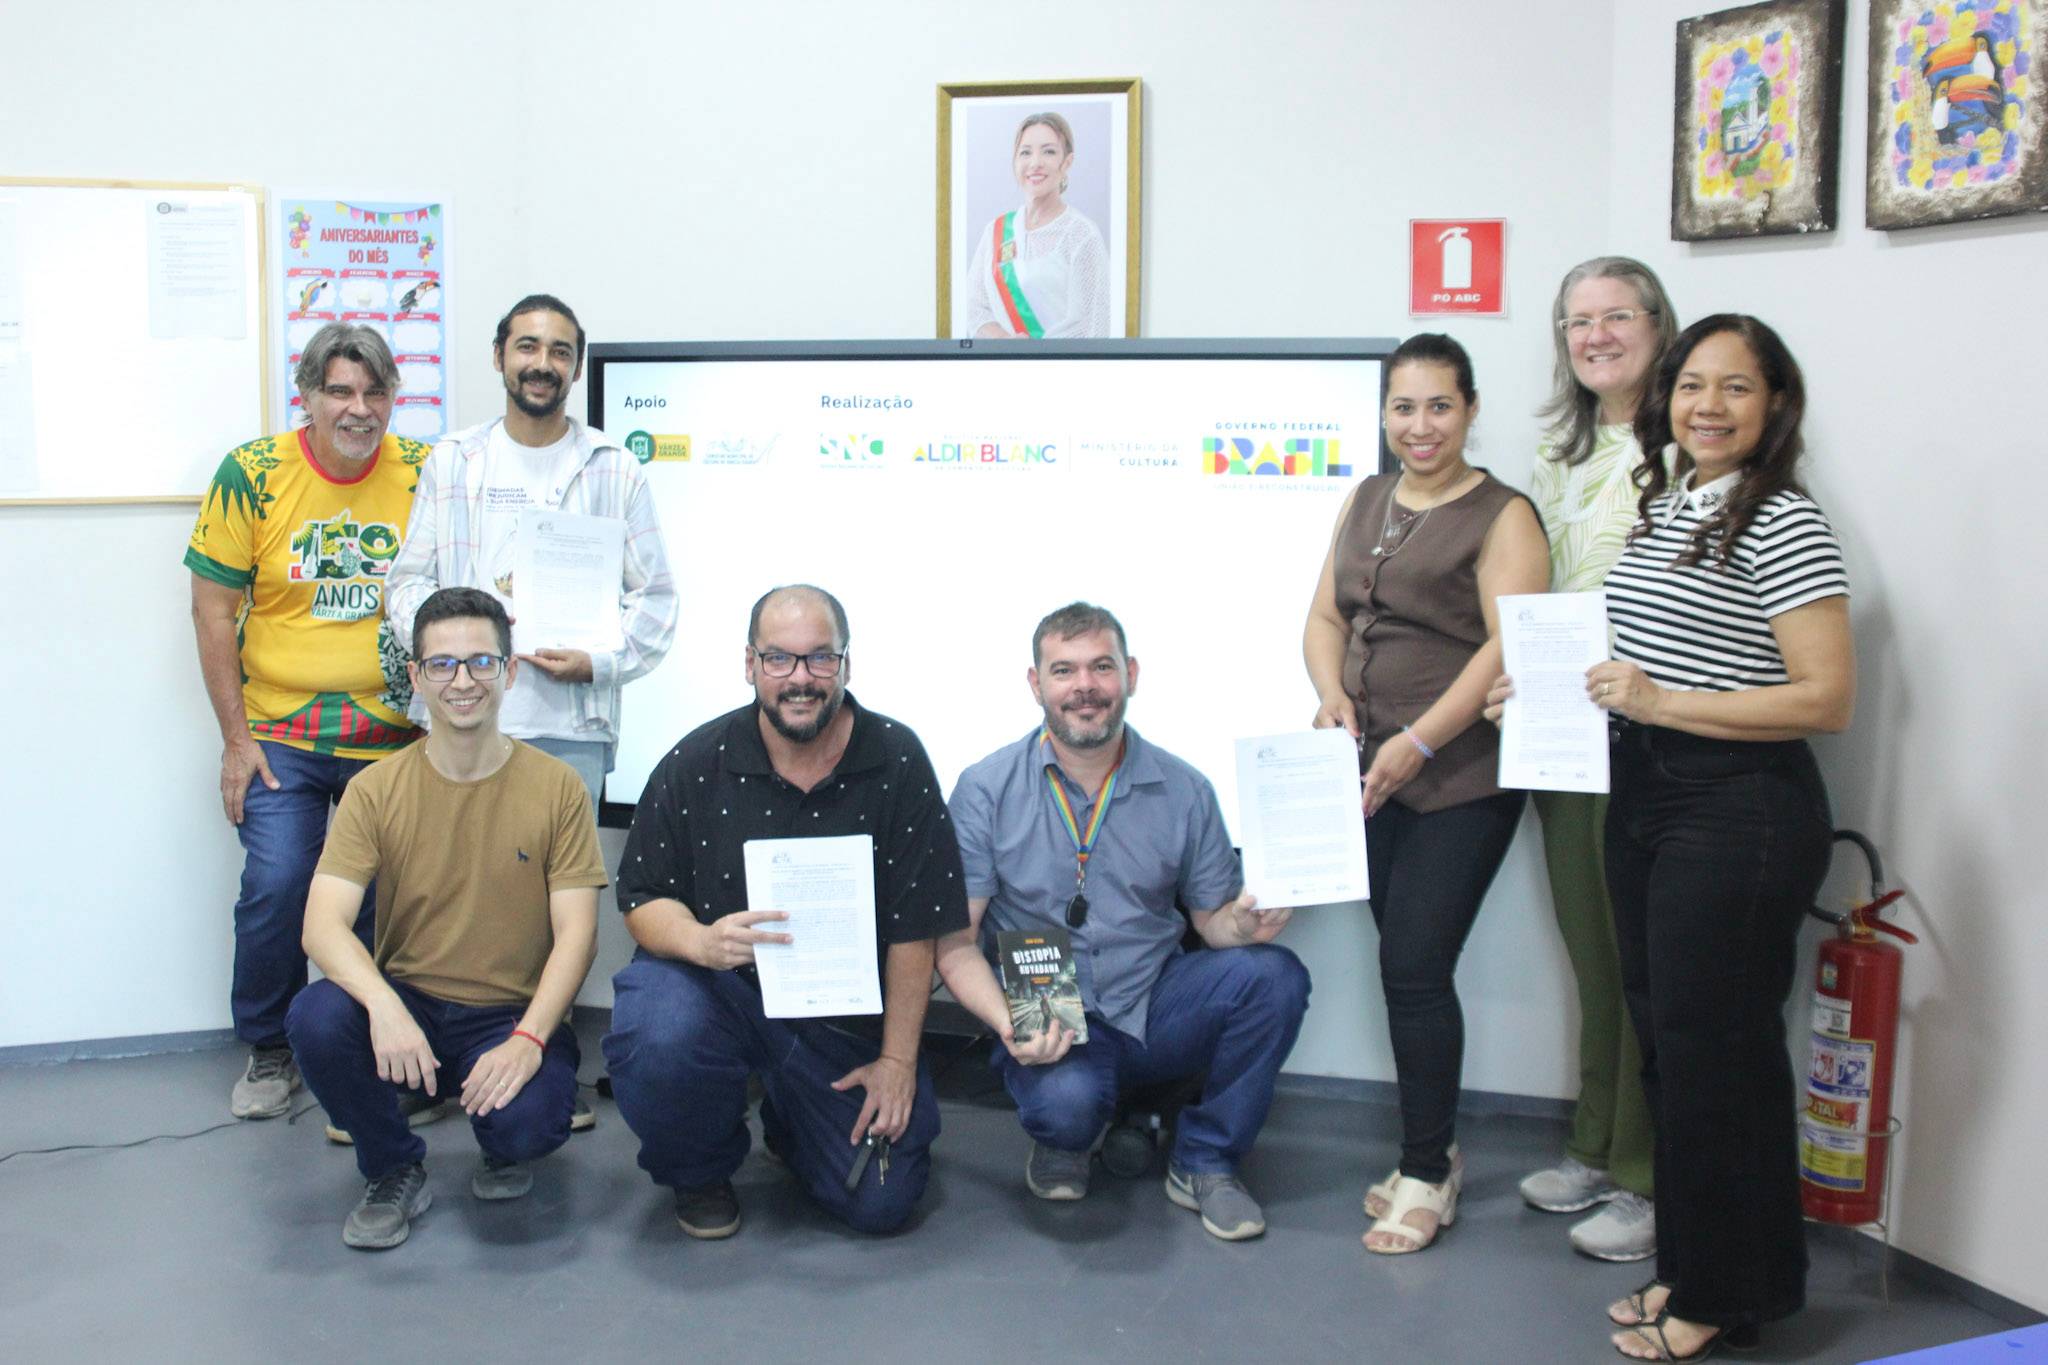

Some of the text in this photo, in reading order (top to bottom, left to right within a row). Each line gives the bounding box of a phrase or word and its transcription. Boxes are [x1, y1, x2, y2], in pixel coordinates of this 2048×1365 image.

[320, 228, 419, 244] ANIVERSARIANTES
[348, 246, 389, 264] DO MÊS
[1455, 293, 1481, 303] ABC
[624, 395, 667, 411] Apoio
[821, 395, 914, 412] Realização
[1215, 422, 1342, 431] GOVERNO FEDERAL
[912, 443, 1057, 463] ALDIR BLANC
[1202, 437, 1353, 477] BRASIL
[1119, 457, 1179, 467] CULTURA
[314, 584, 379, 610] ANOS
[1012, 946, 1062, 965] DISTOPIA
